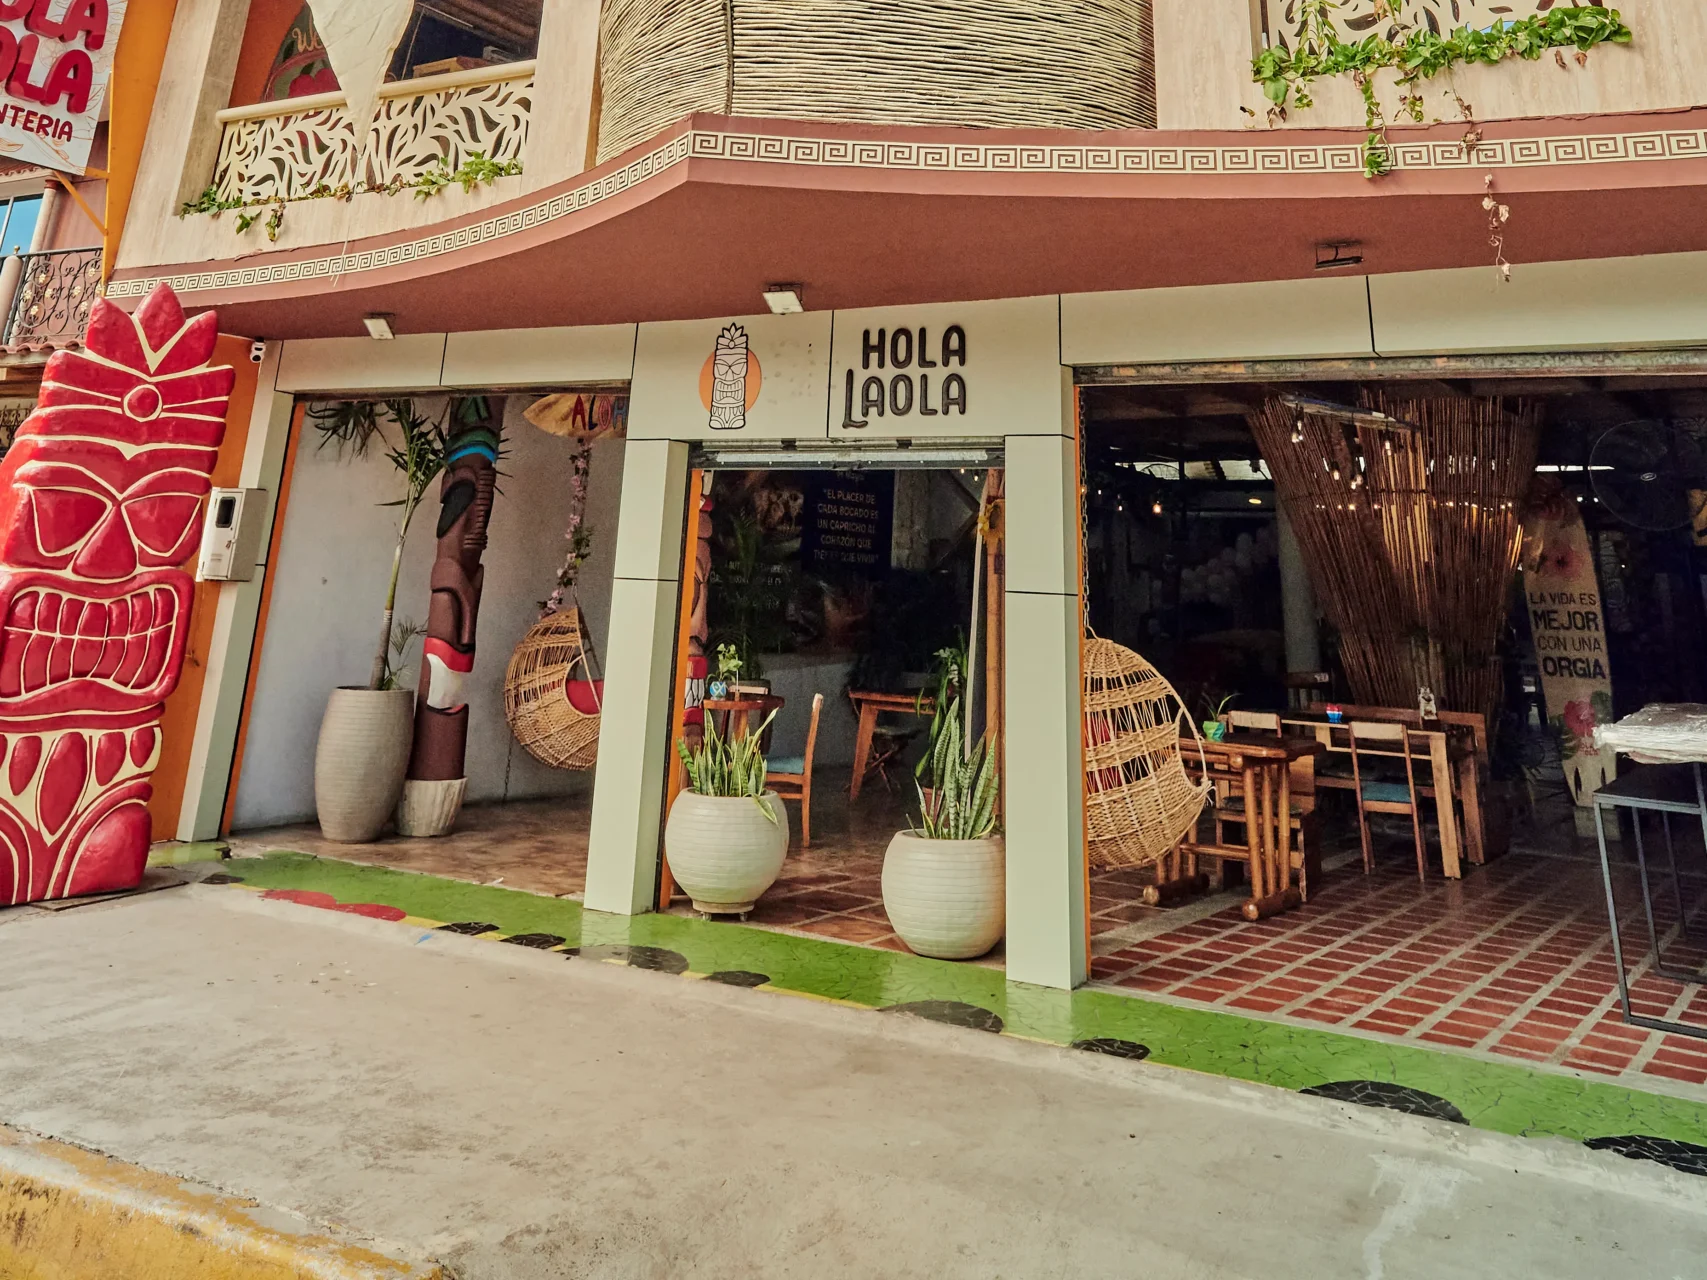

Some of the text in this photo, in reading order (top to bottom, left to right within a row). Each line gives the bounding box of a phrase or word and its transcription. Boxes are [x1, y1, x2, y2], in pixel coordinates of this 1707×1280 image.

[862, 325, 966, 369] HOLA
[842, 368, 966, 429] LAOLA
[837, 489, 865, 503] PLACER
[817, 503, 838, 516] CADA
[839, 505, 869, 518] BOCADO
[817, 518, 828, 529] UN
[829, 520, 867, 533] CAPRICHO
[857, 538, 873, 549] QUE
[1530, 592, 1597, 606] LA VIDA ES
[1532, 609, 1600, 631] MEJOR
[1537, 635, 1603, 652] CON UNA
[1542, 656, 1606, 679] ORGIA
